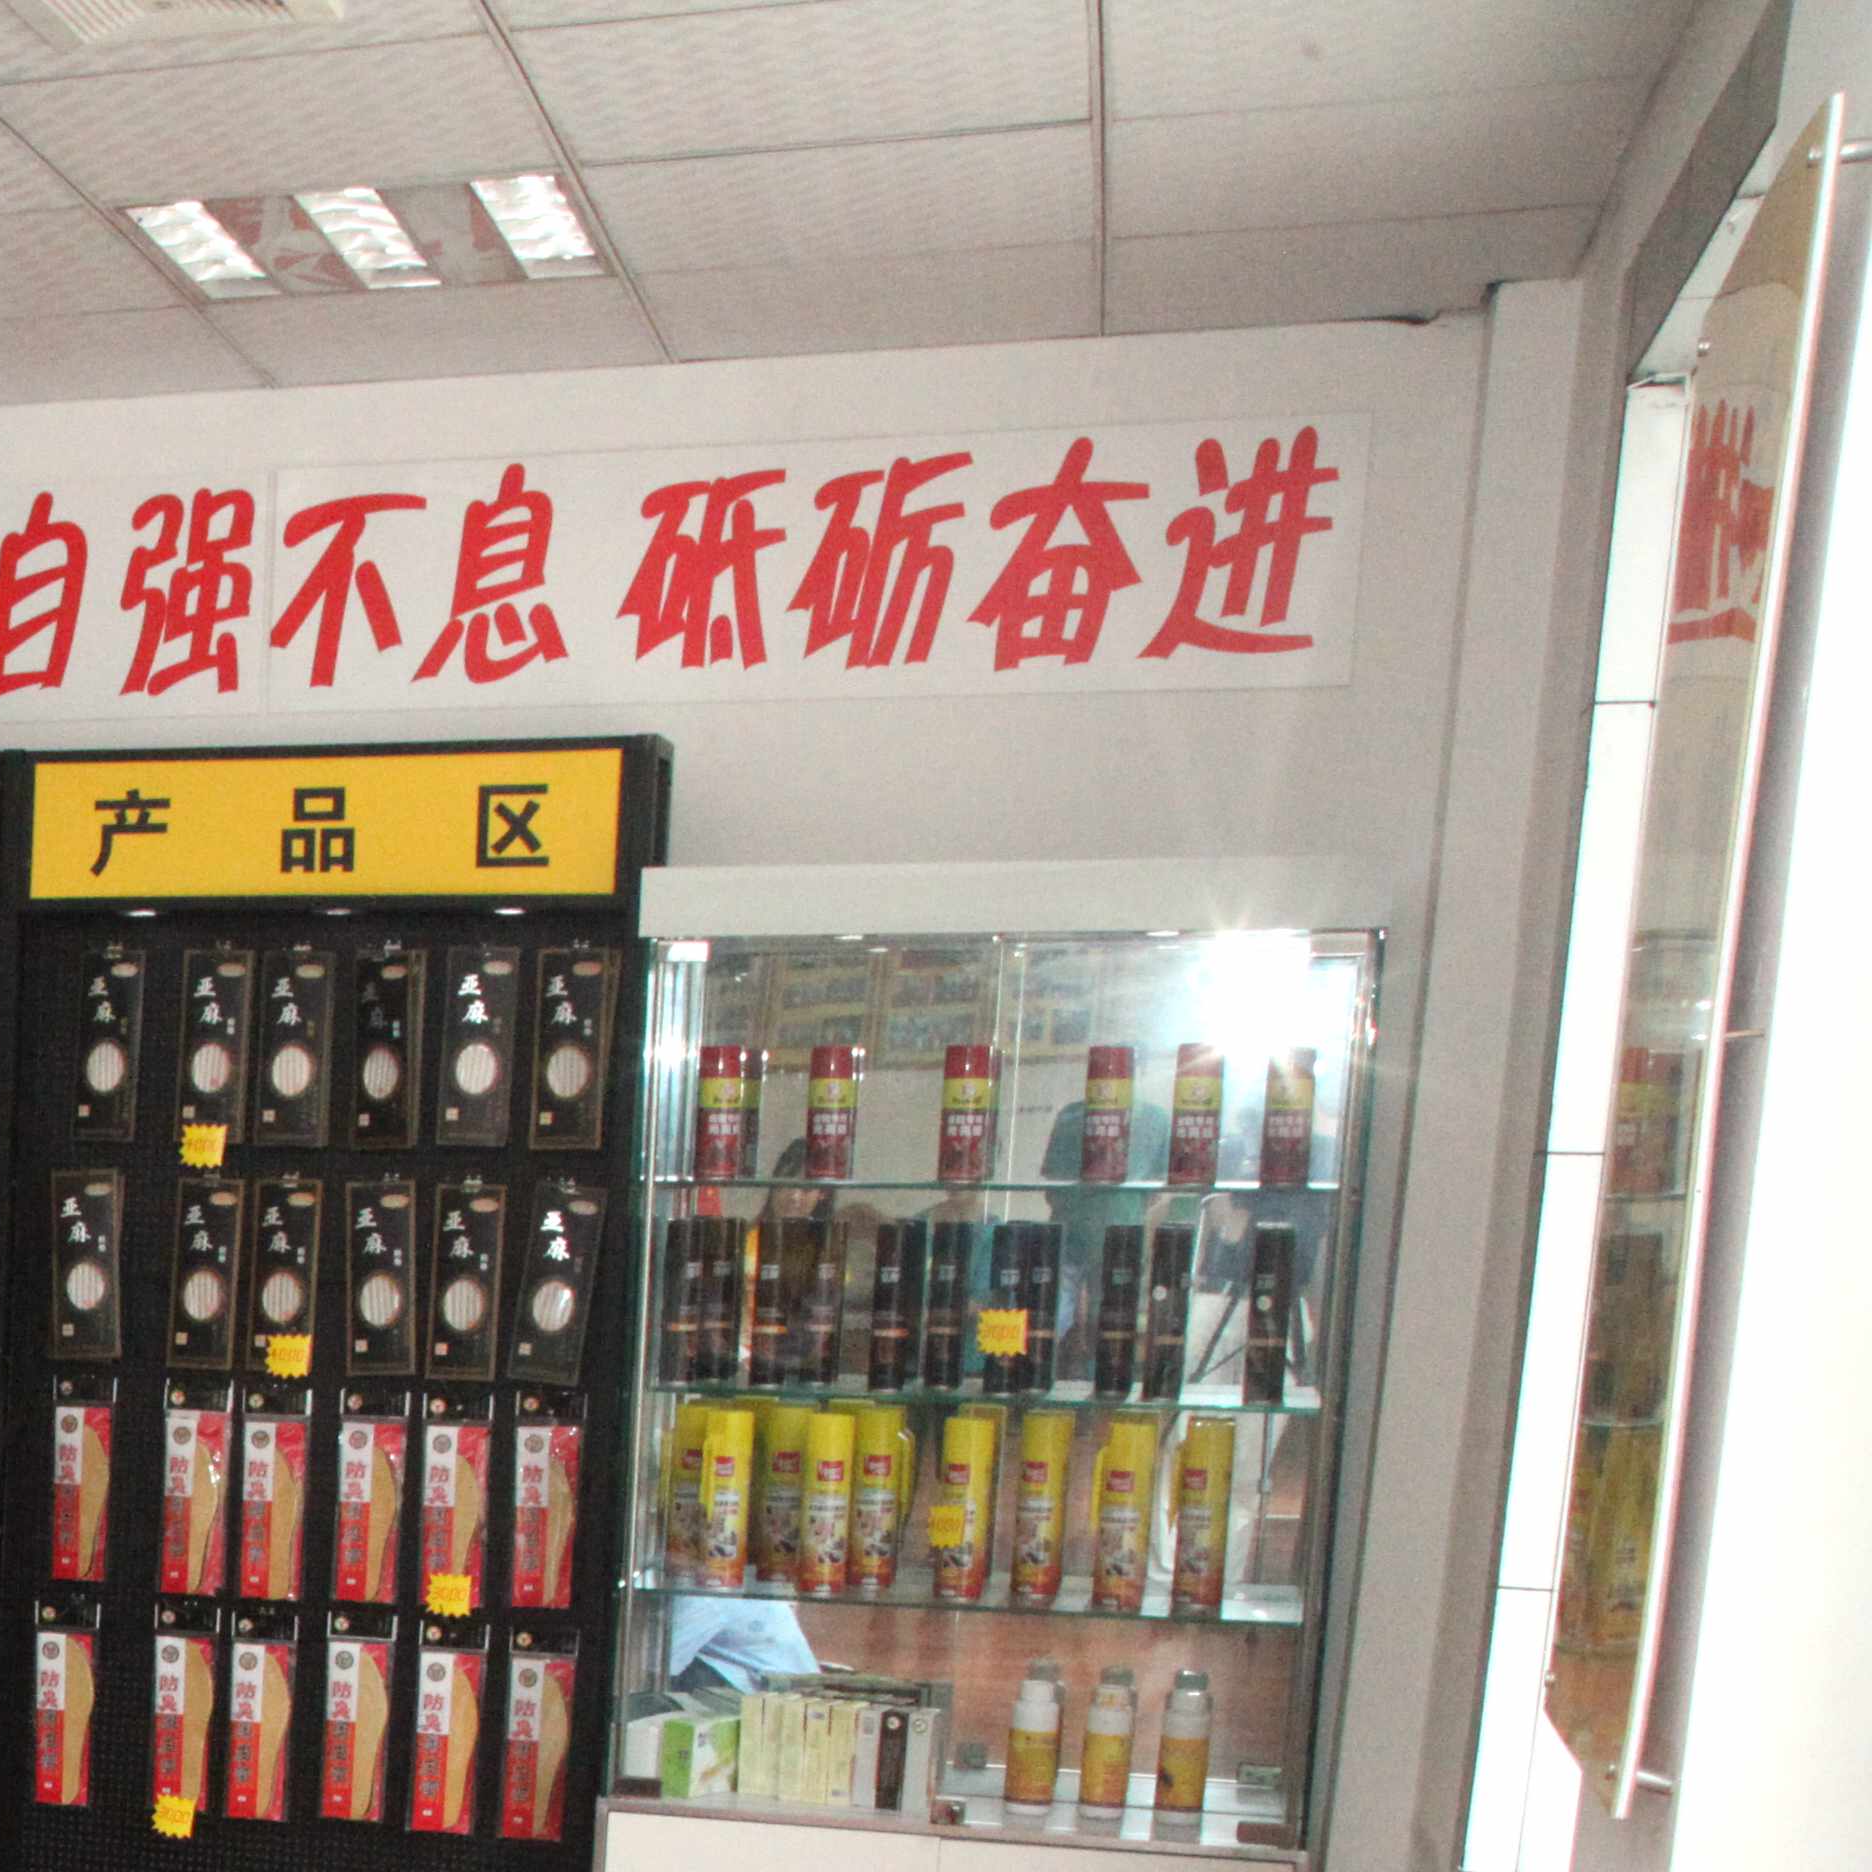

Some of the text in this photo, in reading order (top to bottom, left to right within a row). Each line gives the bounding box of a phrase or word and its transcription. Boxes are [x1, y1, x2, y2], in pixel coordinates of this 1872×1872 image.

[620, 427, 1338, 670] 砥砺奋进
[91, 783, 550, 876] 产品区
